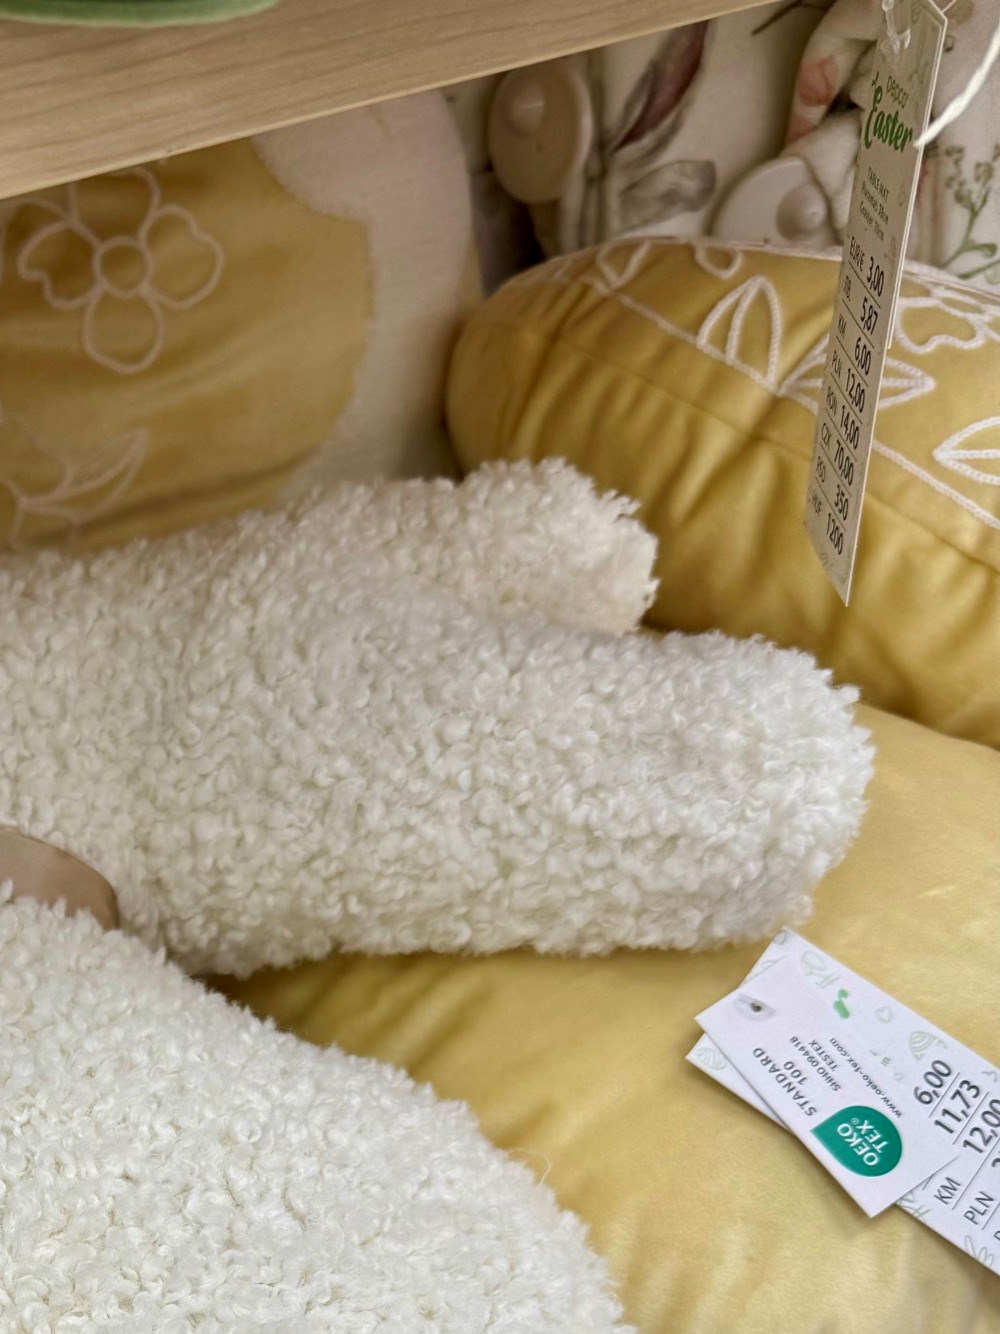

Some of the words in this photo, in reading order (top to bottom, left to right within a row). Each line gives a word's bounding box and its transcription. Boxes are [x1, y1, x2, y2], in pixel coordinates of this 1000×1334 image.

[864, 73, 913, 153] Easter
[867, 256, 884, 297] 3,00
[860, 296, 878, 335] 5,87
[854, 336, 871, 376] 6,00
[831, 350, 843, 379] PLN
[845, 368, 865, 414] 12,00
[840, 405, 860, 450] 14,00
[821, 422, 832, 451] CZK
[834, 439, 854, 486] 70,00
[834, 483, 849, 521] 350
[826, 512, 844, 556] 1200
[789, 1036, 819, 1067] 094418
[808, 1039, 839, 1071] TESTEX
[752, 1047, 817, 1117] STANDARD
[783, 1061, 808, 1086] 100
[816, 1066, 842, 1092] SHHO
[829, 1037, 902, 1118] www.oeko-tex.com
[913, 1059, 952, 1106] 6,00
[934, 1079, 981, 1135] 11,73
[836, 1123, 880, 1166] OEKO
[933, 1176, 961, 1205] KM
[963, 1190, 995, 1226] PLN
